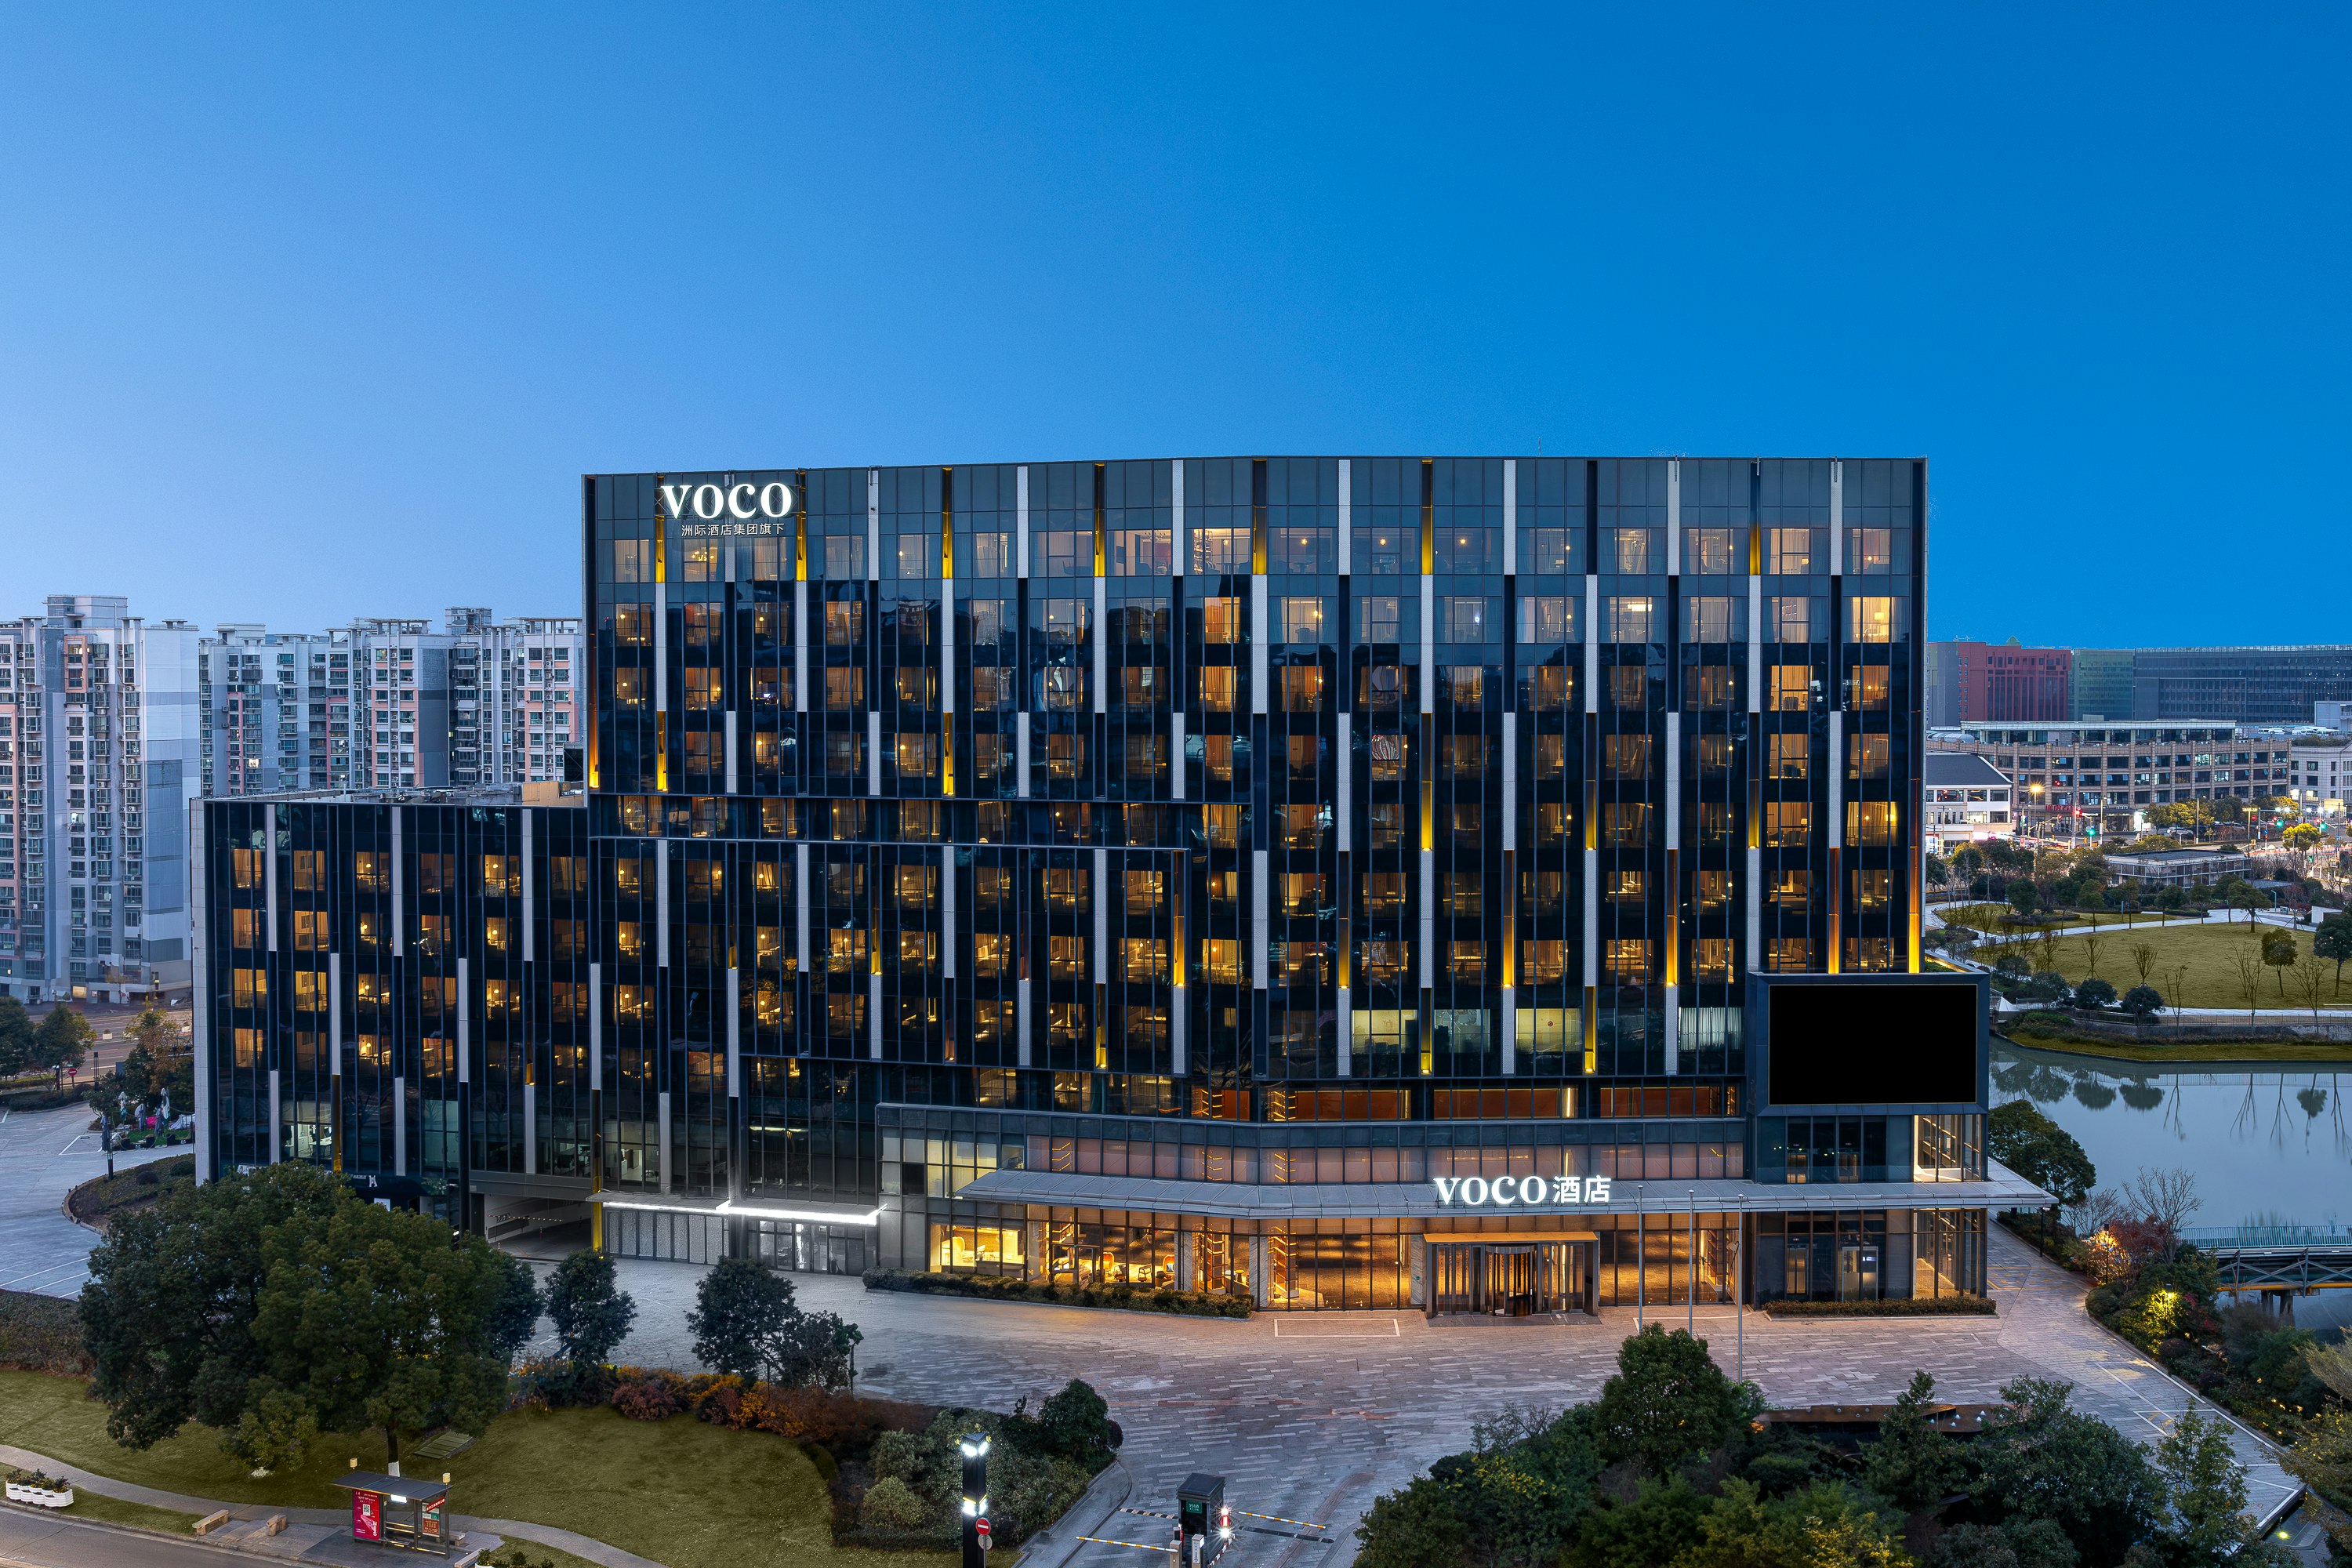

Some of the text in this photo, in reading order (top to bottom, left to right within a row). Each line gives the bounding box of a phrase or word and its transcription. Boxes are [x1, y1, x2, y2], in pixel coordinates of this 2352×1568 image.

[681, 523, 785, 536] 洲际酒店集团旗下
[1552, 1175, 1612, 1203] 酒店
